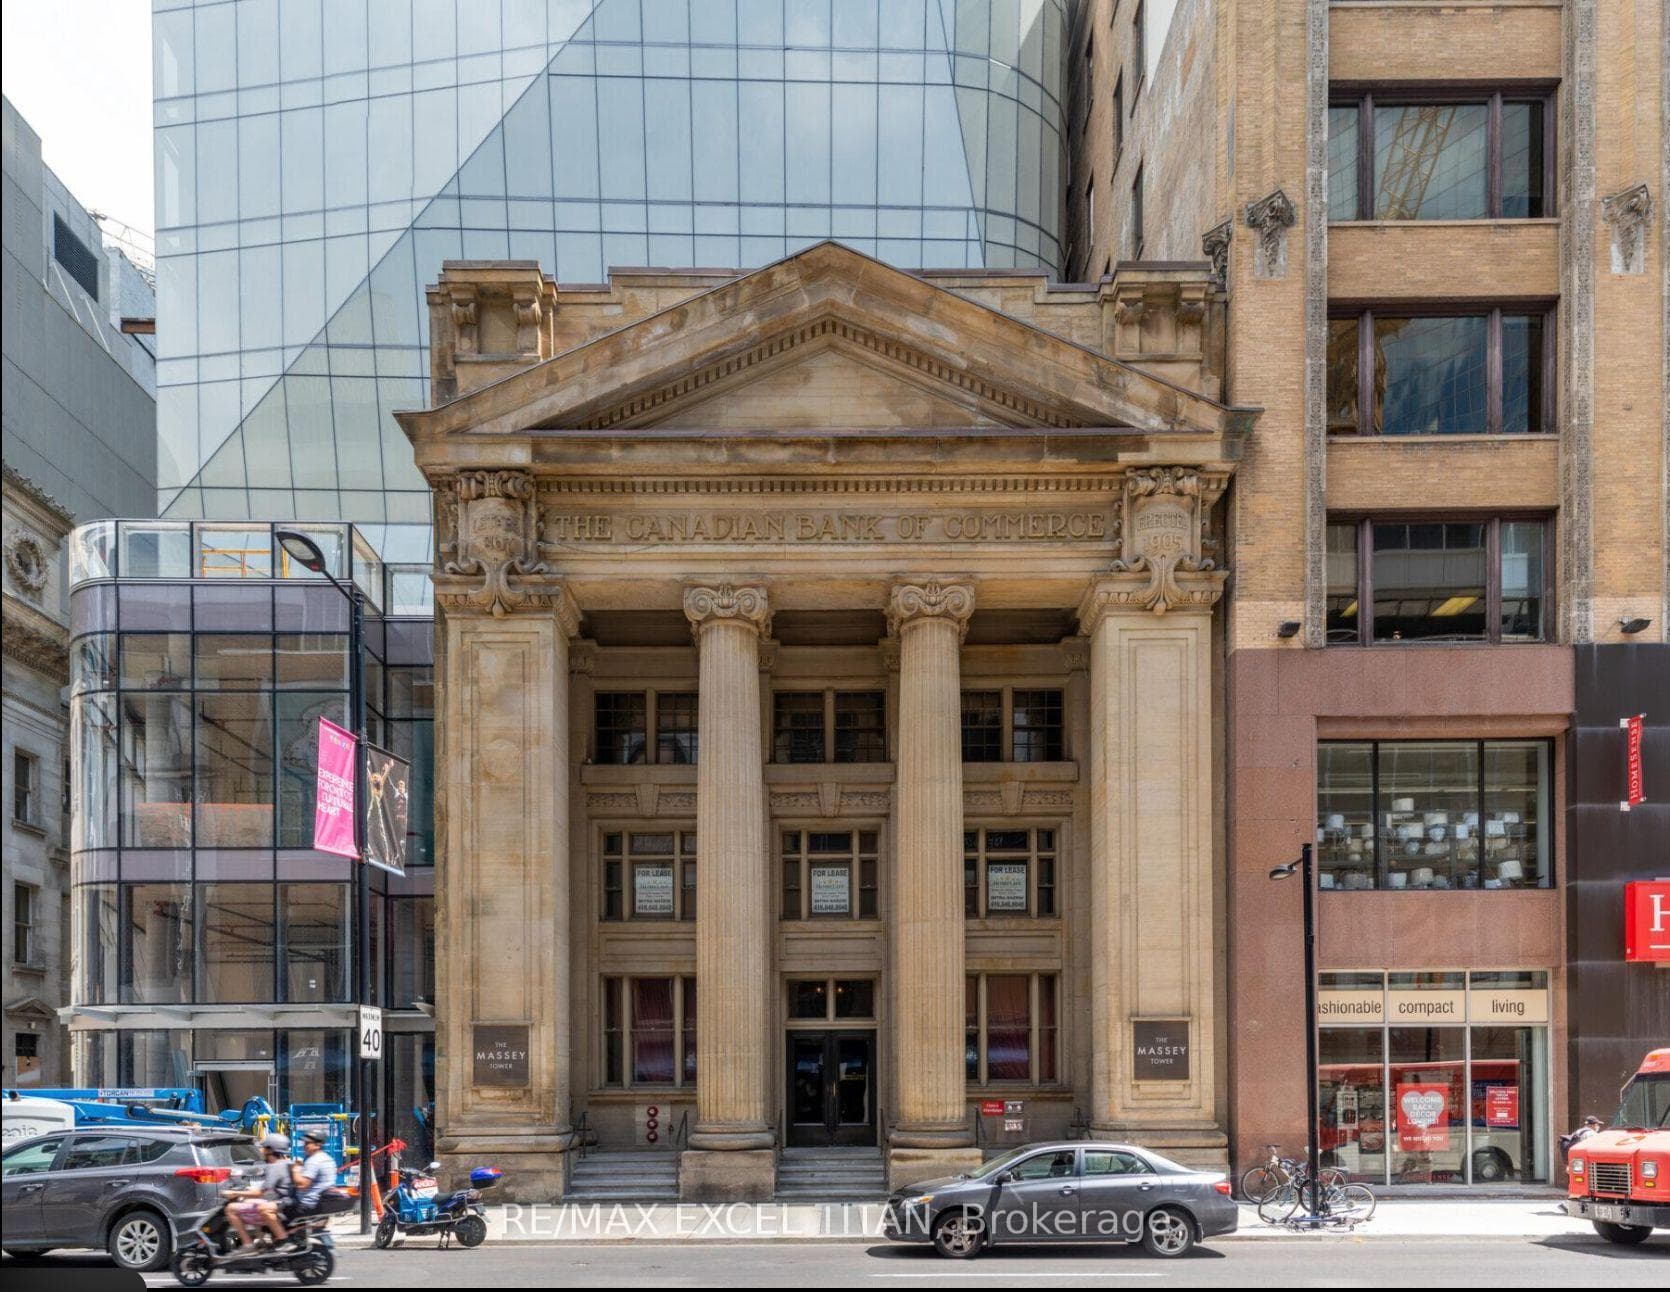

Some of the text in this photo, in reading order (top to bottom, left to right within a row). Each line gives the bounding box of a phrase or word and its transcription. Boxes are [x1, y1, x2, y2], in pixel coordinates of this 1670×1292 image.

[556, 512, 1105, 541] THE CANADIAN BANK OF COMMERCE
[637, 869, 672, 877] FOR LEASE
[813, 869, 847, 877] FOR LEASE
[990, 866, 1025, 874] FOR LEASE
[1398, 1000, 1454, 1016] compact
[1491, 1000, 1525, 1016] living
[363, 1028, 380, 1051] 40
[1137, 1046, 1187, 1055] MASSEY
[476, 1051, 526, 1060] MASSEY
